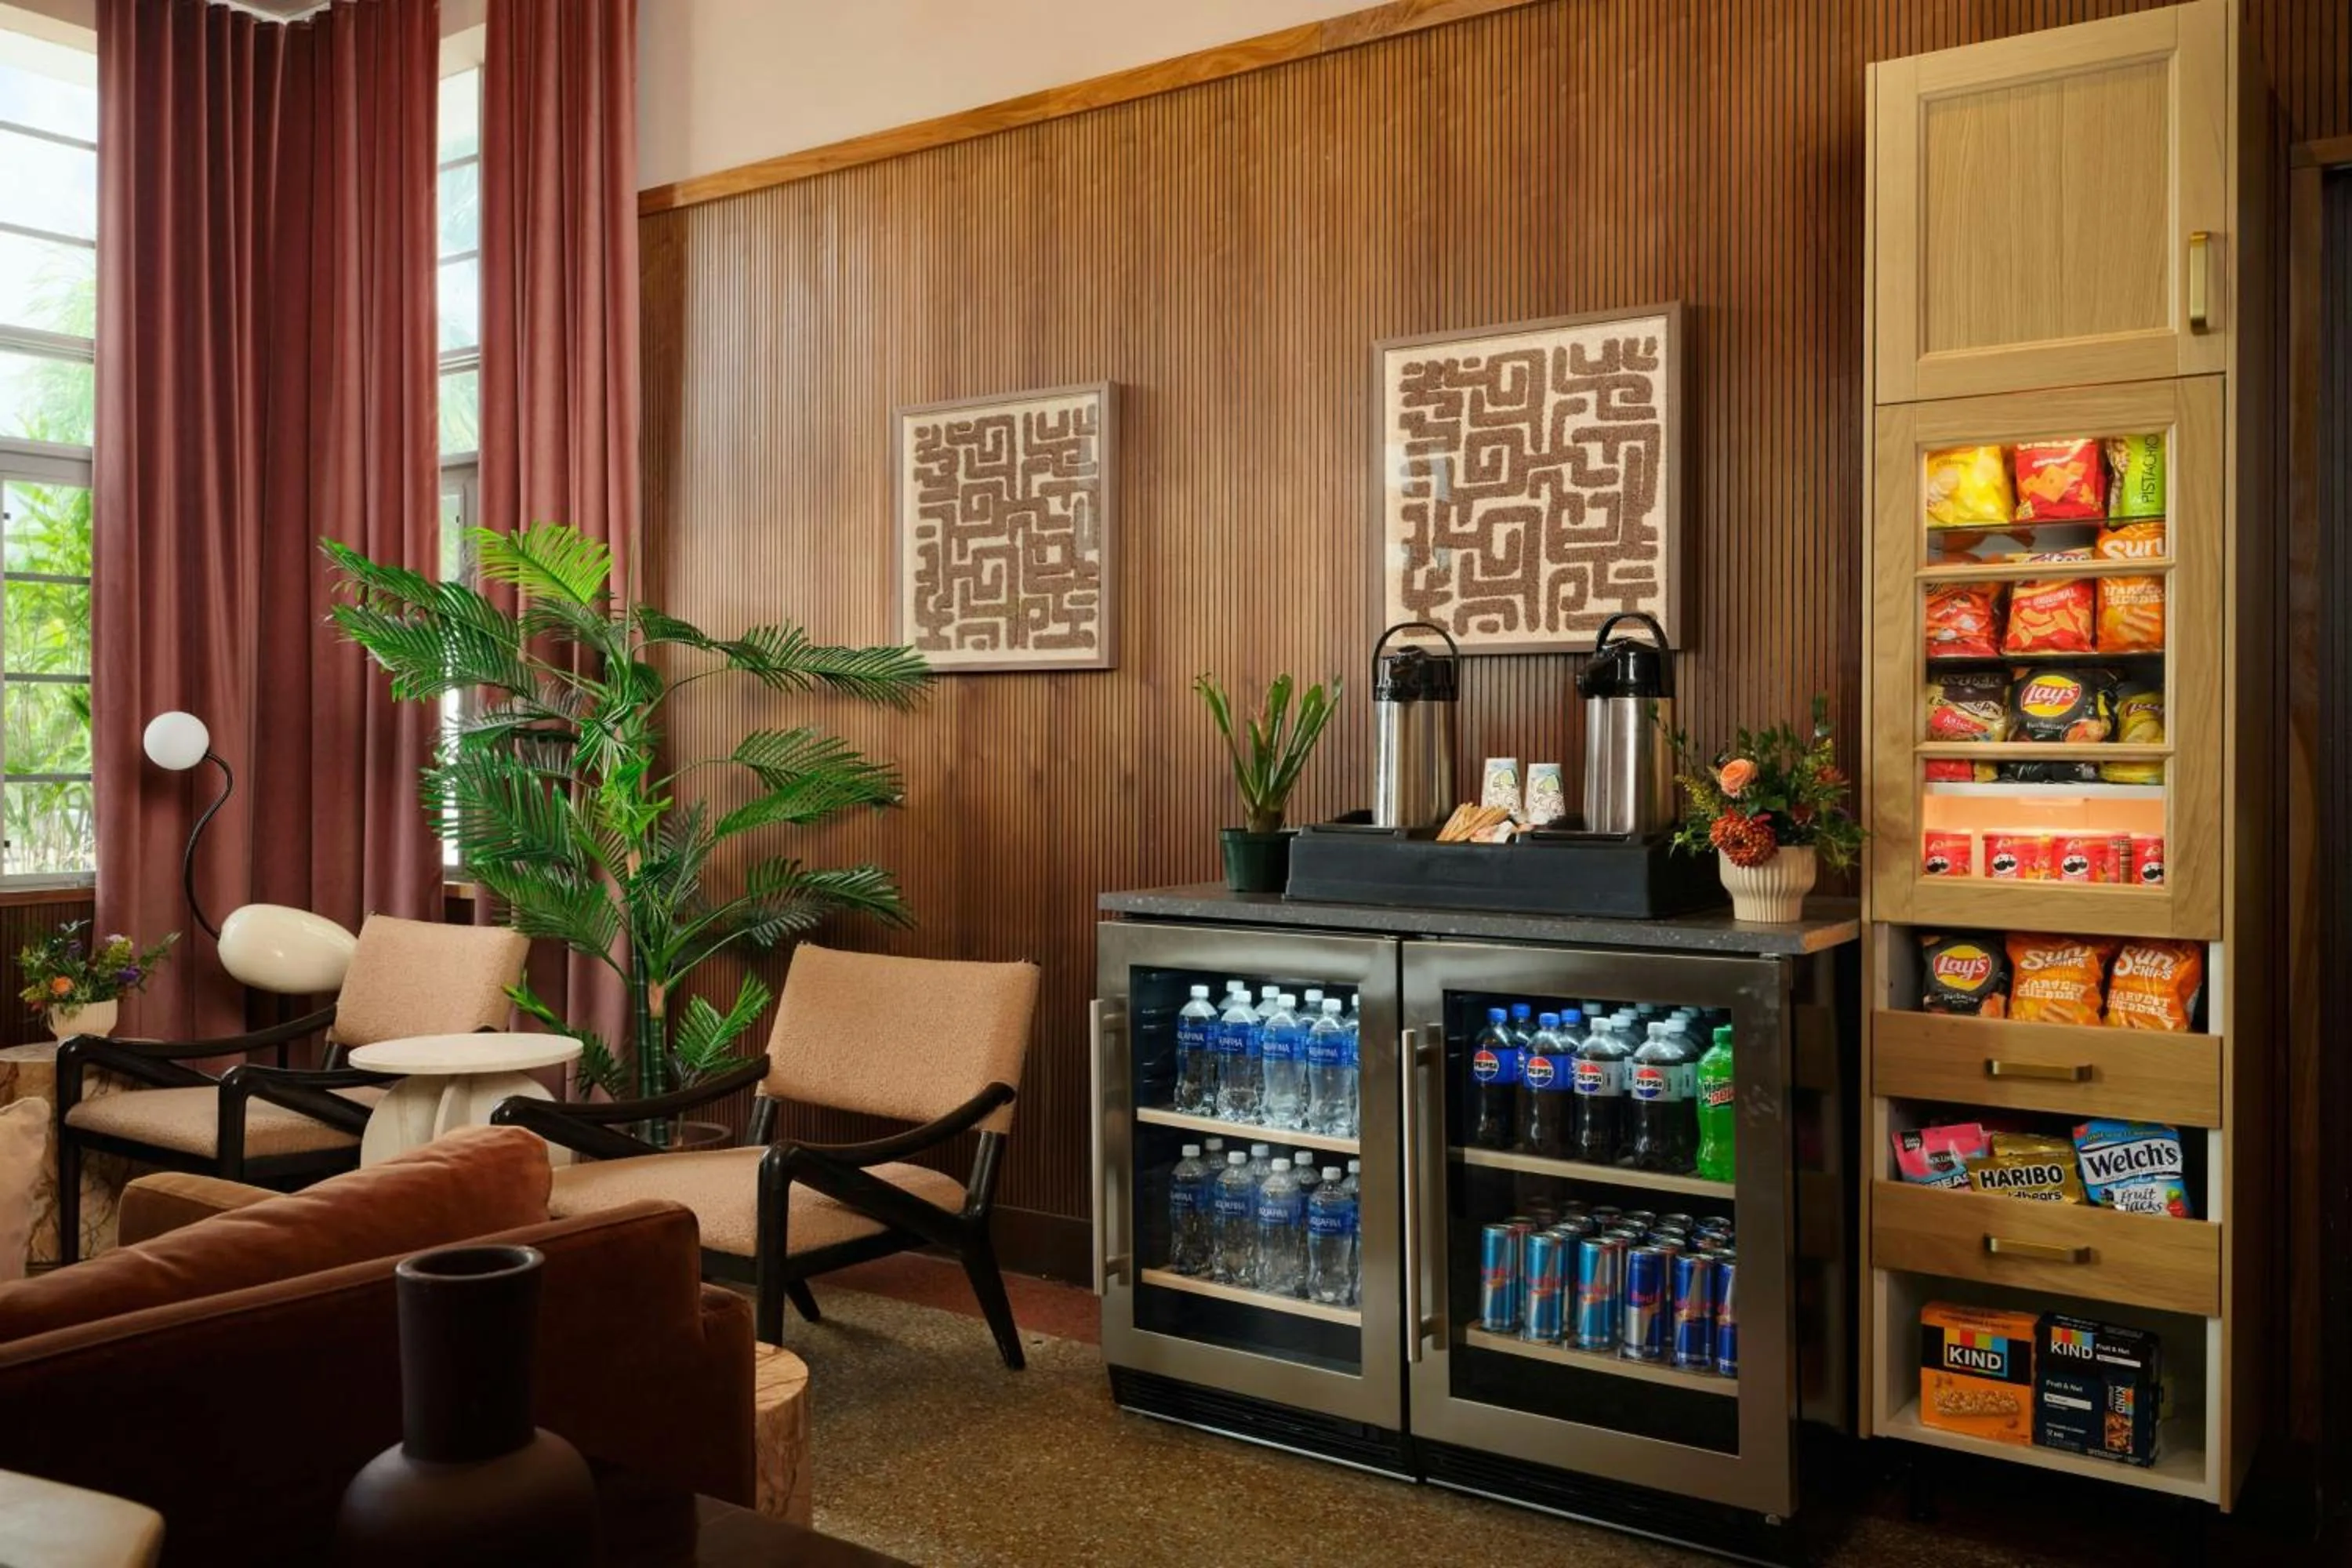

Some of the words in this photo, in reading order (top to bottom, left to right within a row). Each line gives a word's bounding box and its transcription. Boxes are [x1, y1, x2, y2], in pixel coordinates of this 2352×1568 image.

[1474, 1061, 1498, 1069] PEPSI
[1528, 1068, 1552, 1076] PEPSI
[1577, 1073, 1602, 1083] PEPSI
[1635, 1078, 1662, 1088] PEPSI
[2085, 1143, 2178, 1178] Welch's
[1980, 1164, 2063, 1189] HARIBO
[2121, 1188, 2156, 1203] fruit
[1949, 1346, 2002, 1370] KIND
[2050, 1341, 2093, 1360] KIND
[2114, 1385, 2125, 1414] KIND
